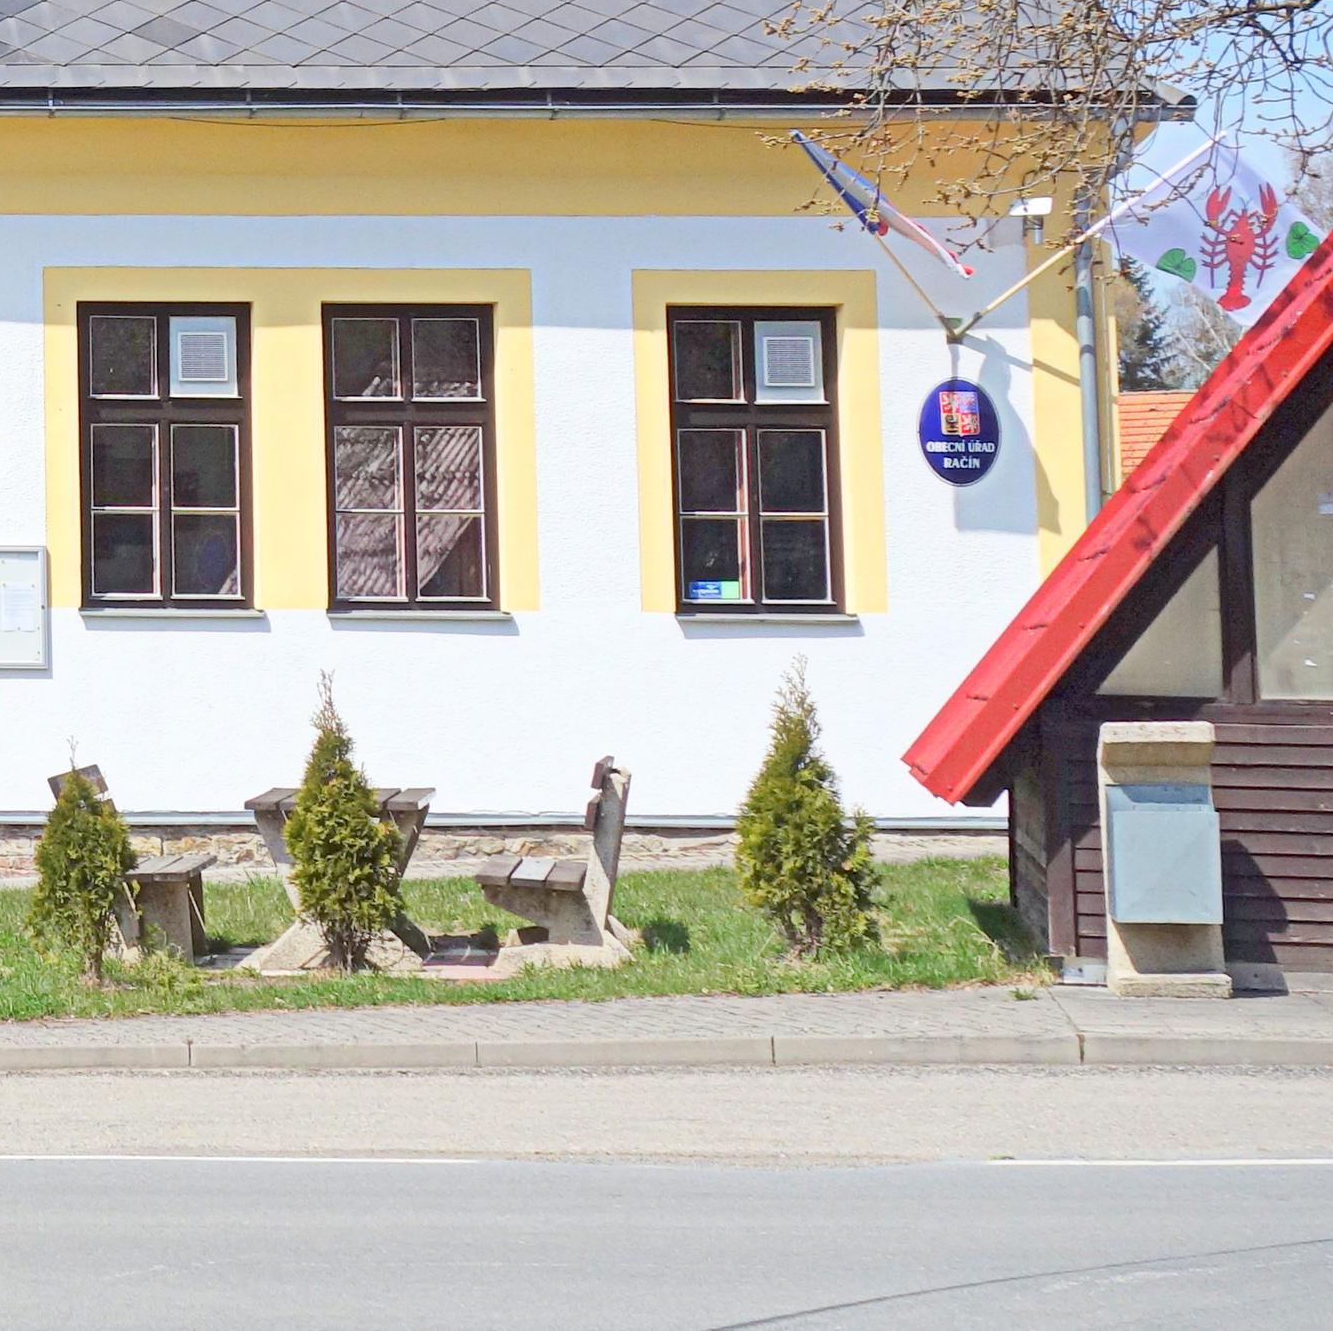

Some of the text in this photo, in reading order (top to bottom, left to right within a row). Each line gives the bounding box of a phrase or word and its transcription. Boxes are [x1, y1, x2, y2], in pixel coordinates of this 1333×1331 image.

[926, 439, 995, 453] OBECNÍ ÚŘAD
[943, 455, 981, 469] RAČÍN
